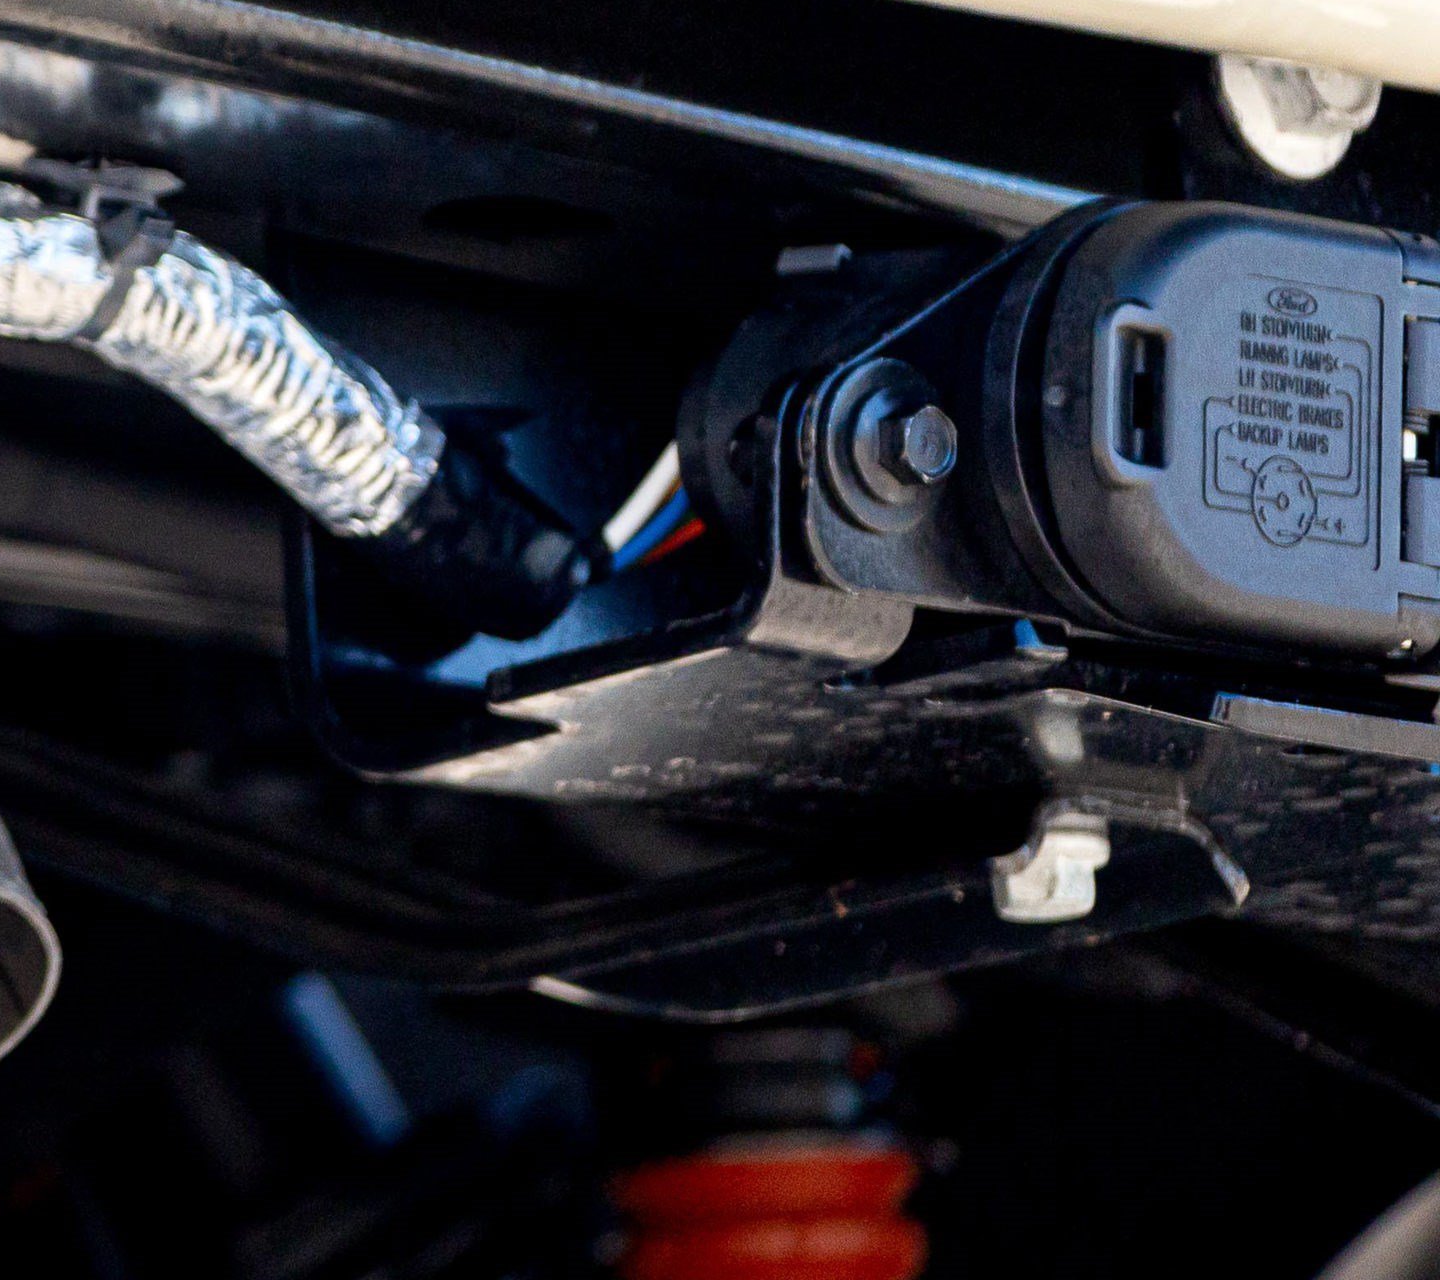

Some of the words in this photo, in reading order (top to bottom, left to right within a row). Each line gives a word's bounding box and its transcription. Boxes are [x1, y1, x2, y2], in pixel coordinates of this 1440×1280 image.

[1240, 340, 1290, 367] RUNNING
[1293, 348, 1337, 375] LAMPS
[1238, 393, 1293, 423] ELECTRIC
[1298, 402, 1344, 431] BRAKES
[1237, 420, 1284, 447] BACKUP
[1288, 429, 1330, 455] LAMPS
